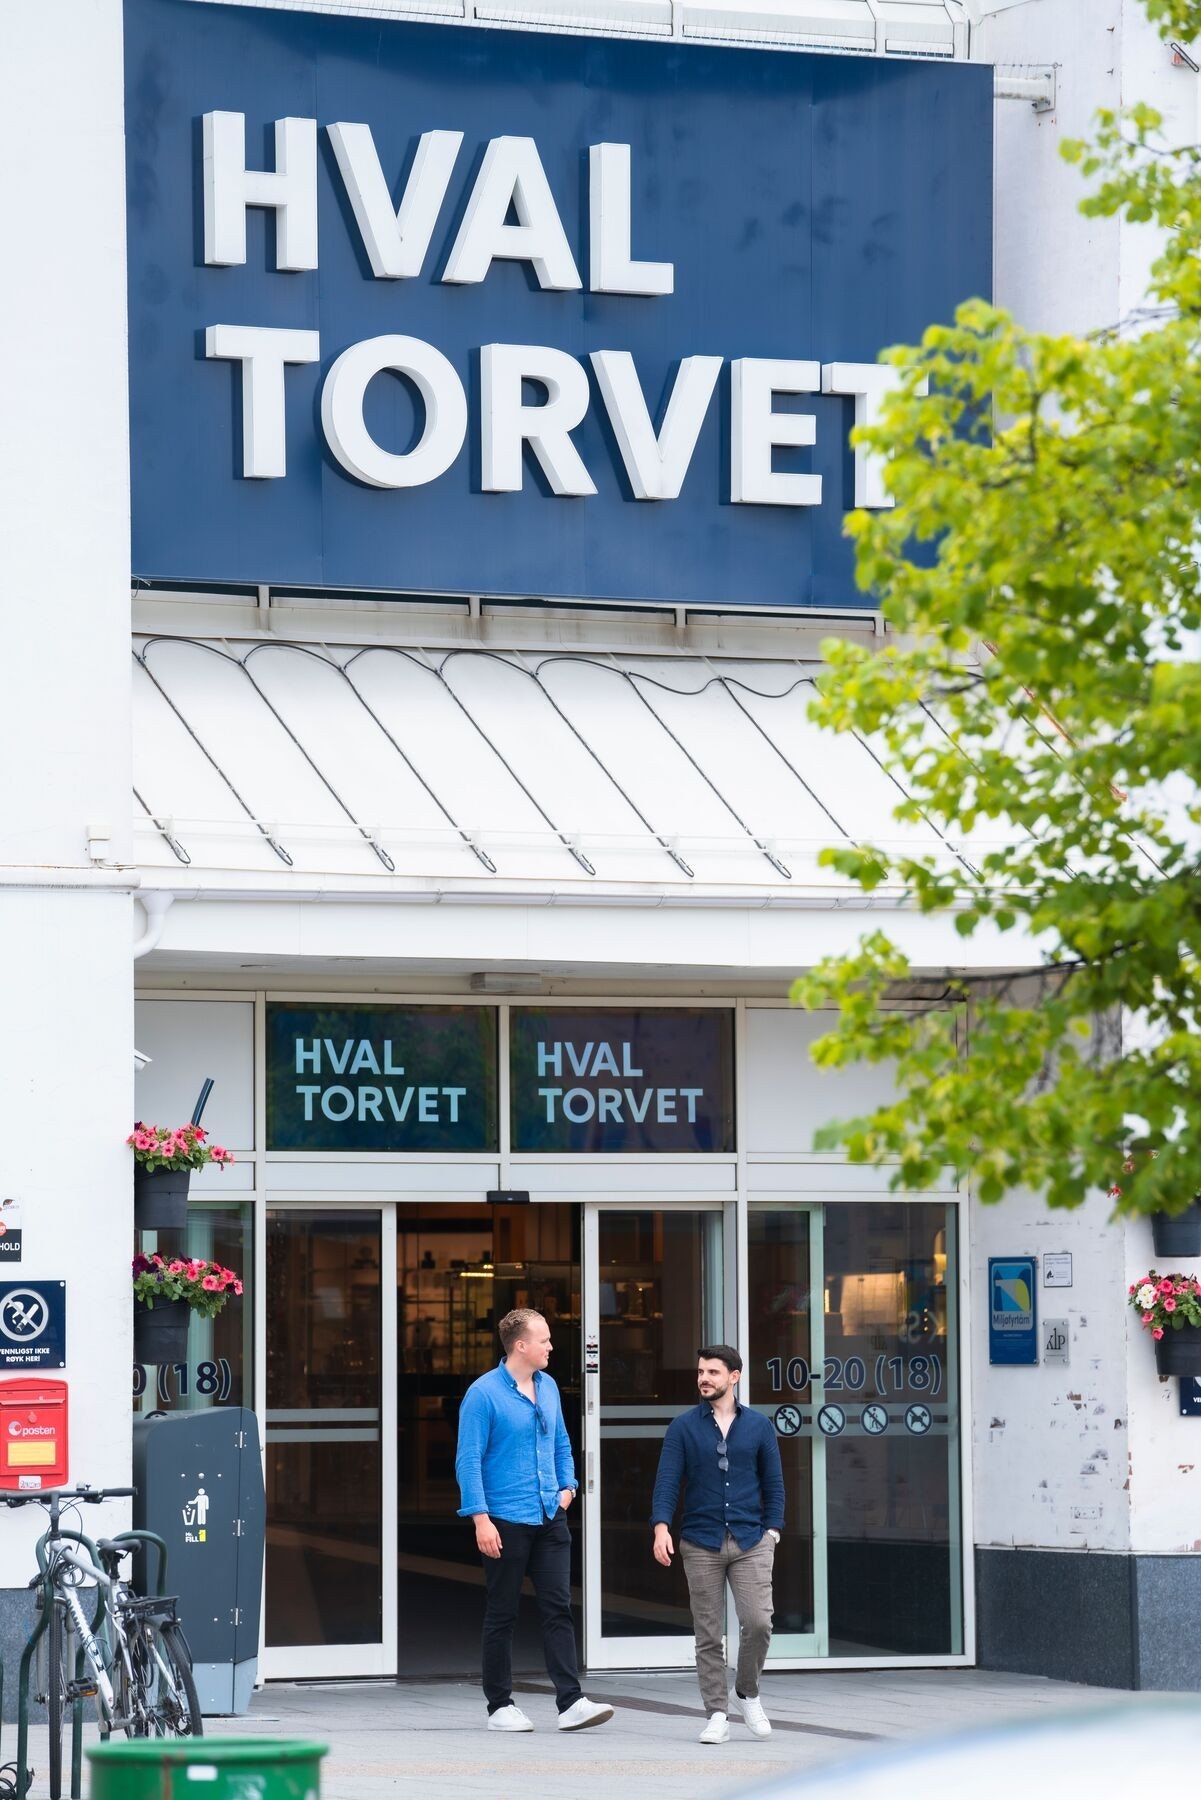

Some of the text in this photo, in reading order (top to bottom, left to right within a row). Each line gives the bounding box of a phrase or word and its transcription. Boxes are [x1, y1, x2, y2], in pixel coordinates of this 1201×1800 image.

[203, 110, 674, 295] HVAL
[205, 324, 929, 509] TORVET
[295, 1038, 405, 1075] HVAL
[537, 1041, 643, 1077] HVAL
[296, 1085, 466, 1123] TORVET
[538, 1087, 704, 1124] TORVET
[158, 1358, 232, 1402] (18)
[766, 1355, 942, 1396] 10-20 (18)
[22, 1425, 56, 1437] posten
